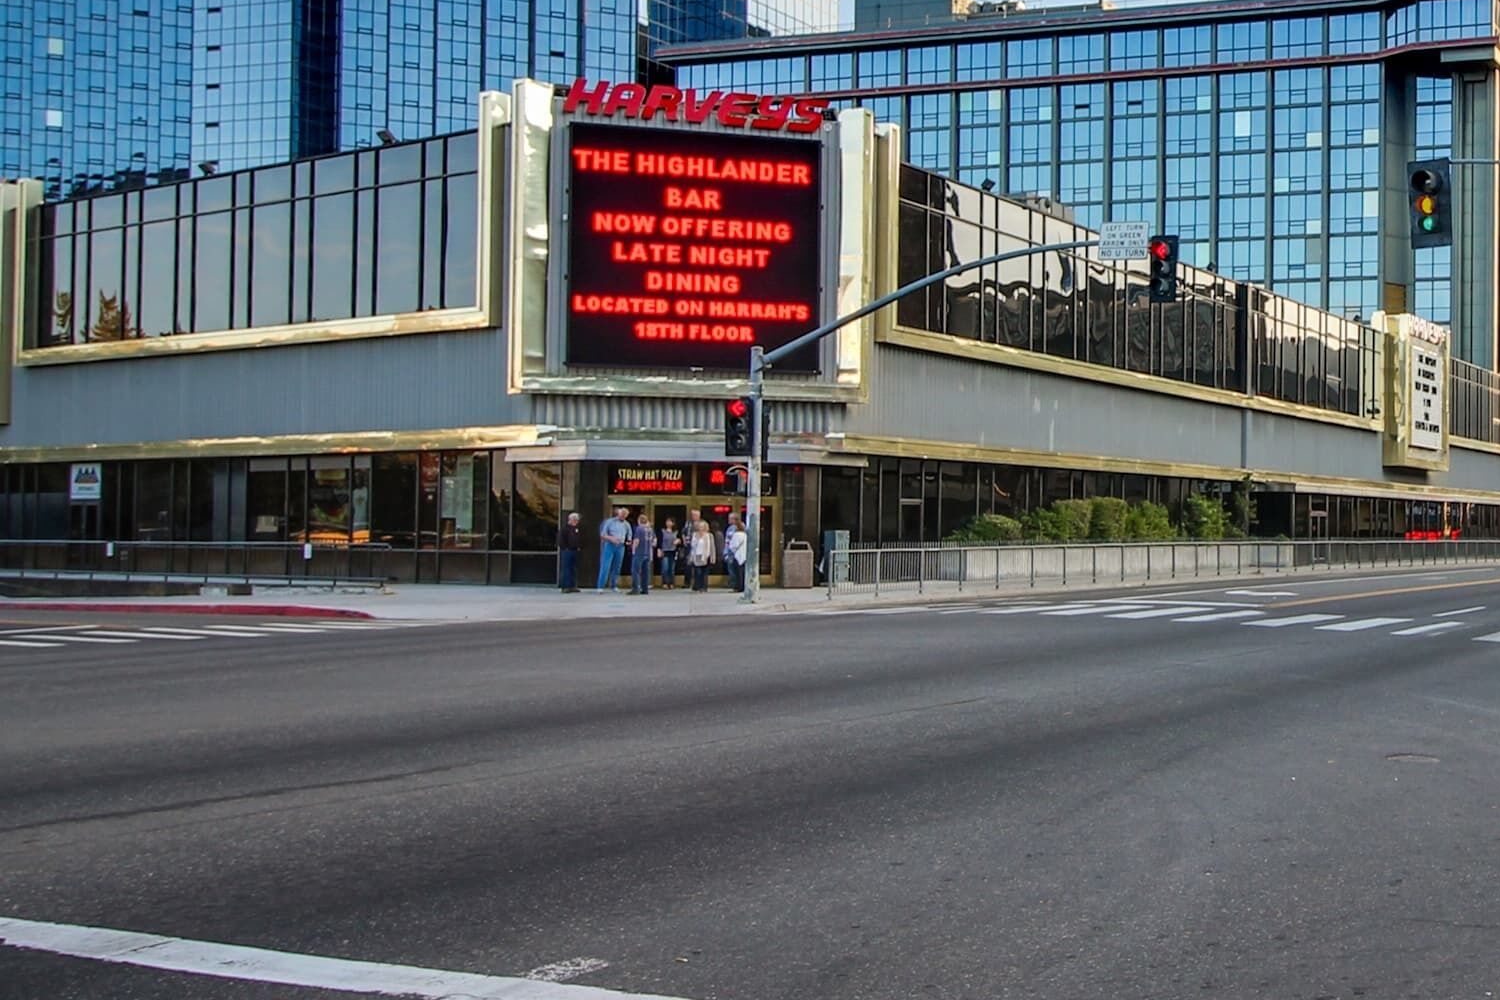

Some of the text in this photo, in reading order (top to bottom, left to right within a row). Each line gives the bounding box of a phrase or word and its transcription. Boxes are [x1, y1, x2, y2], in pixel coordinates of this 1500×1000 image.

[563, 77, 831, 133] HARVEYS
[573, 148, 811, 185] THE HIGHLANDER
[664, 187, 721, 210] BAR
[594, 212, 791, 241] NOW OFFERING
[612, 242, 770, 268] LATE NIGHT
[647, 272, 740, 293] DINING
[573, 295, 809, 321] LOCATED ON HARRAH'S
[634, 323, 753, 342] 18TH FLOOR
[618, 468, 682, 480] STRAW HAT PIZZA
[628, 481, 663, 491] SPORTS
